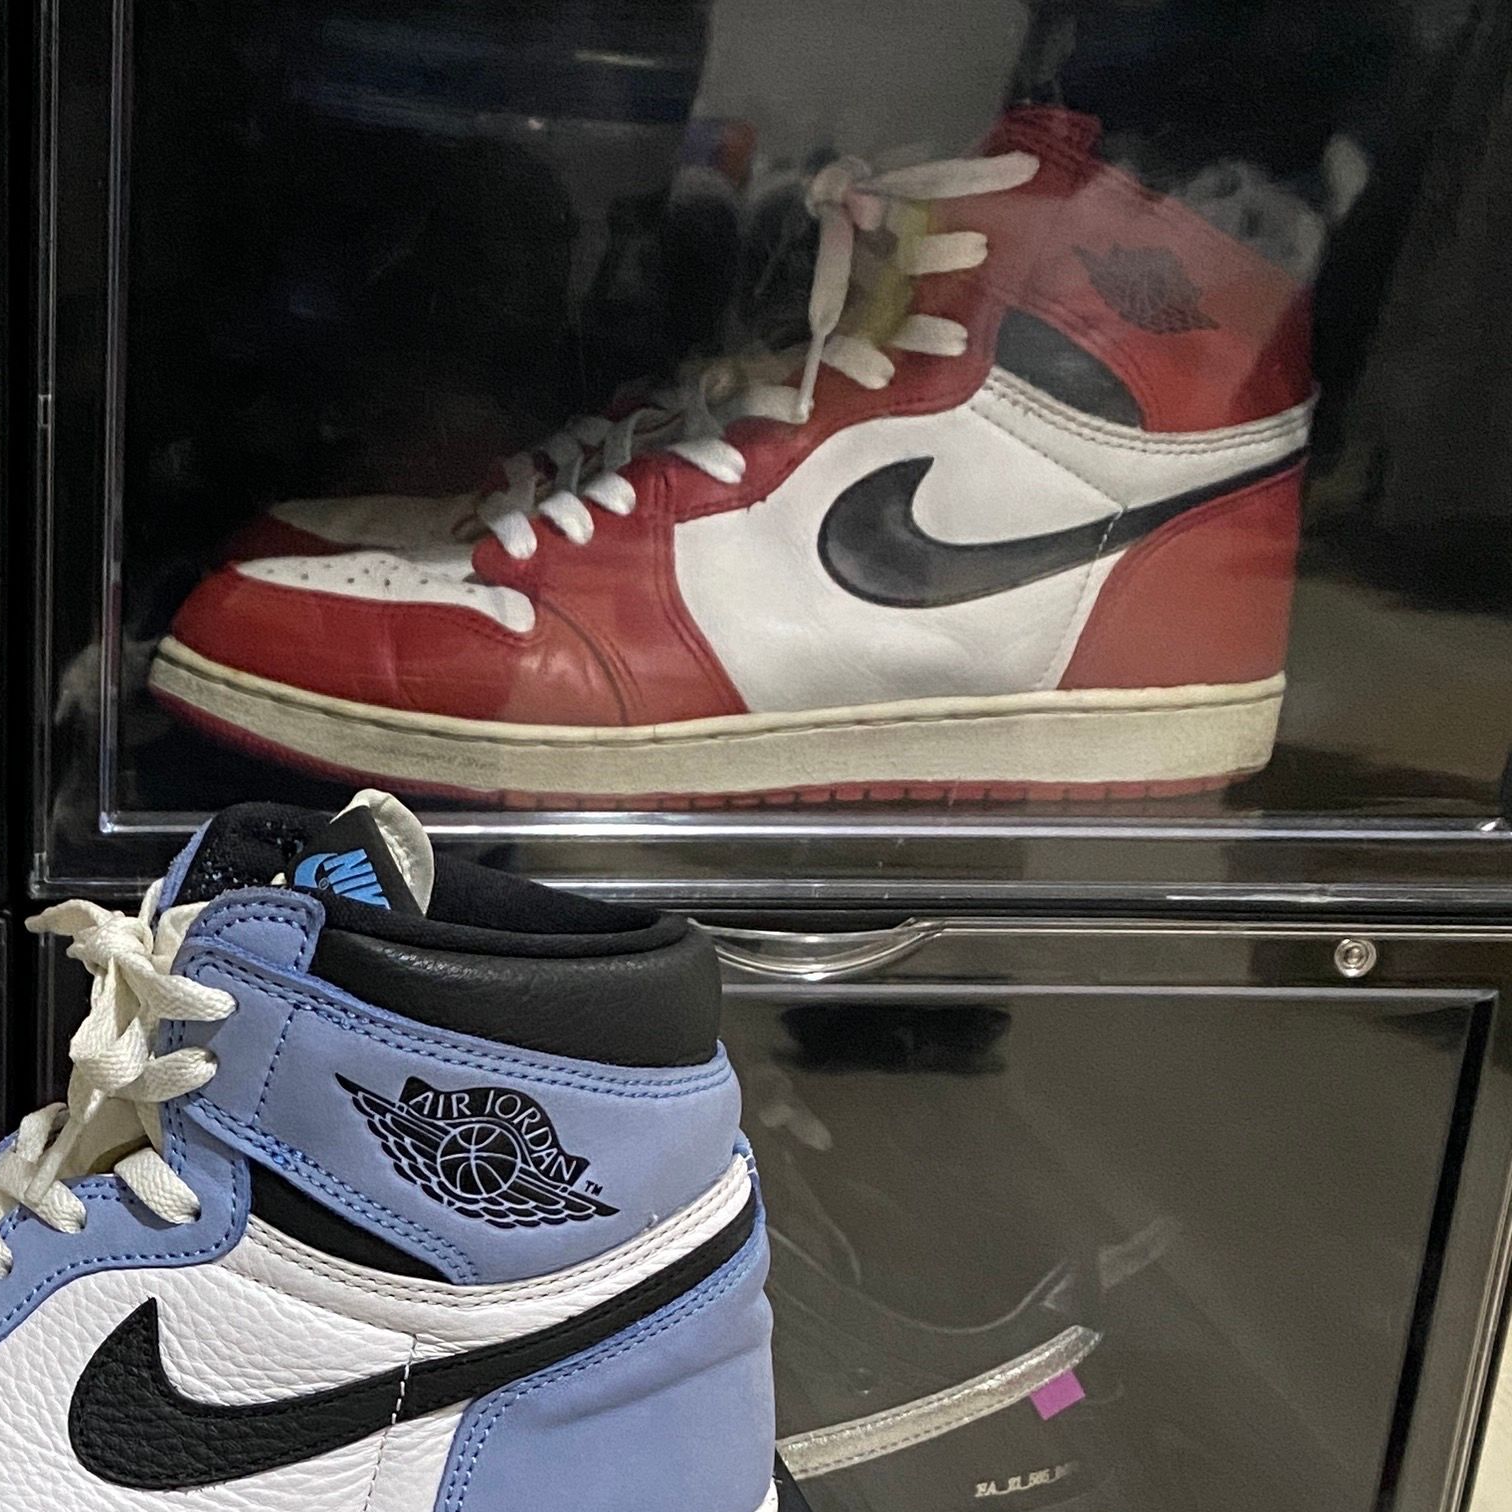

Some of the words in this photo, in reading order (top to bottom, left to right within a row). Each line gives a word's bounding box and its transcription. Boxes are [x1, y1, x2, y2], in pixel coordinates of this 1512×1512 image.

[322, 848, 391, 910] NIK
[409, 1091, 472, 1118] AIR
[484, 1089, 577, 1182] JORDAN
